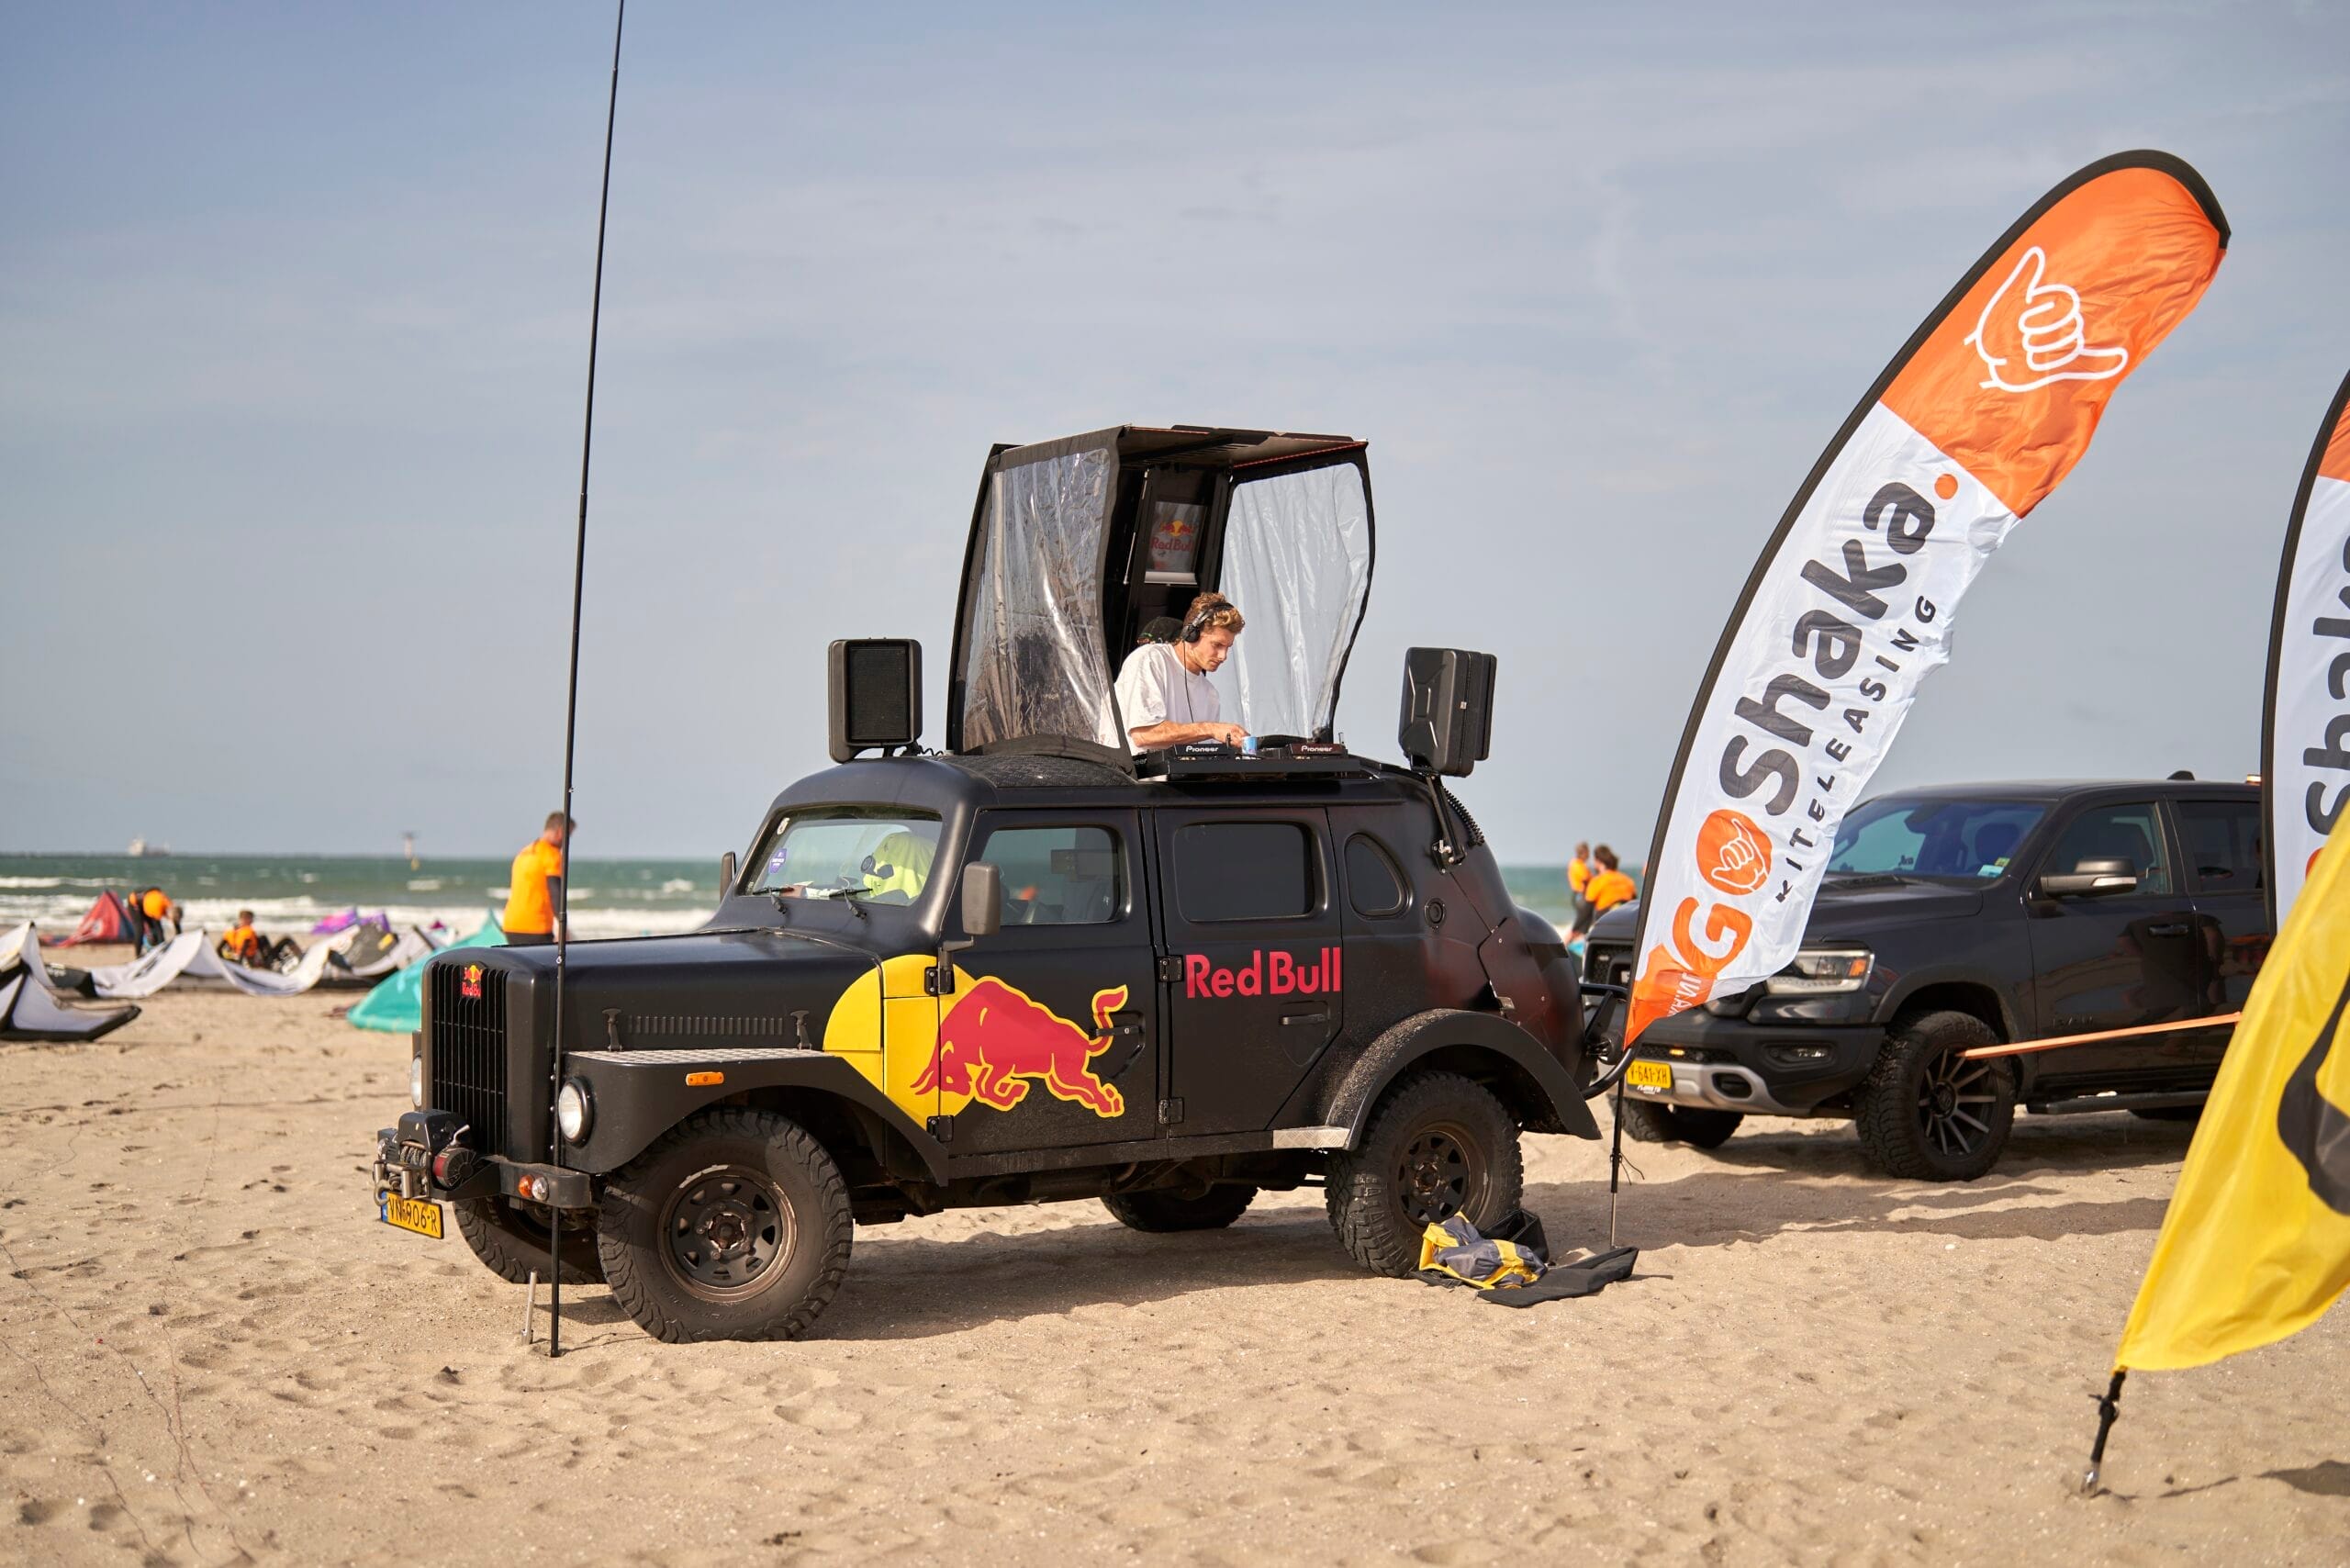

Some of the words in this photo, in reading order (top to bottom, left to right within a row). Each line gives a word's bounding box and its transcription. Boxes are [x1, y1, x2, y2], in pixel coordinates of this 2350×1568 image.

[1151, 537, 1174, 550] Red
[1185, 745, 1219, 753] Pioneer
[1301, 745, 1333, 753] Pioneer
[1186, 950, 1262, 999] Red
[1270, 946, 1341, 994] Bull
